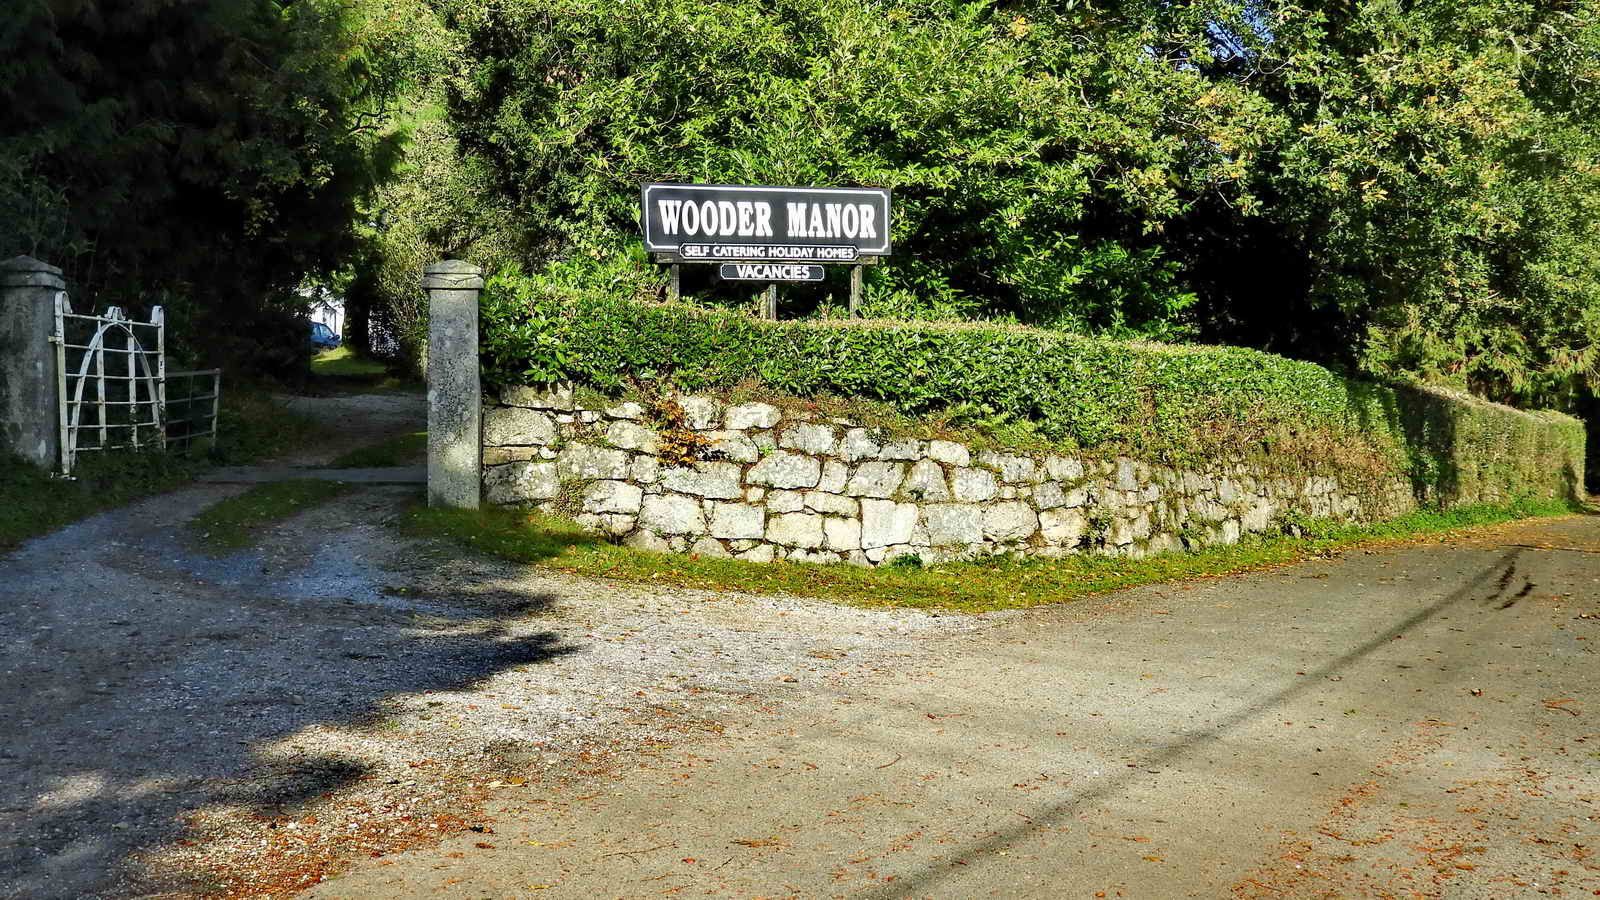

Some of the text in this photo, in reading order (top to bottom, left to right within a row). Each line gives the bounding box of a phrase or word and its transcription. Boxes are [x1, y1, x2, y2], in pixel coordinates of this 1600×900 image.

[658, 199, 877, 239] WOODER MANOR
[684, 246, 855, 259] SELF CATERING HOLIDAY HOMES
[736, 265, 810, 279] VACANCIES
